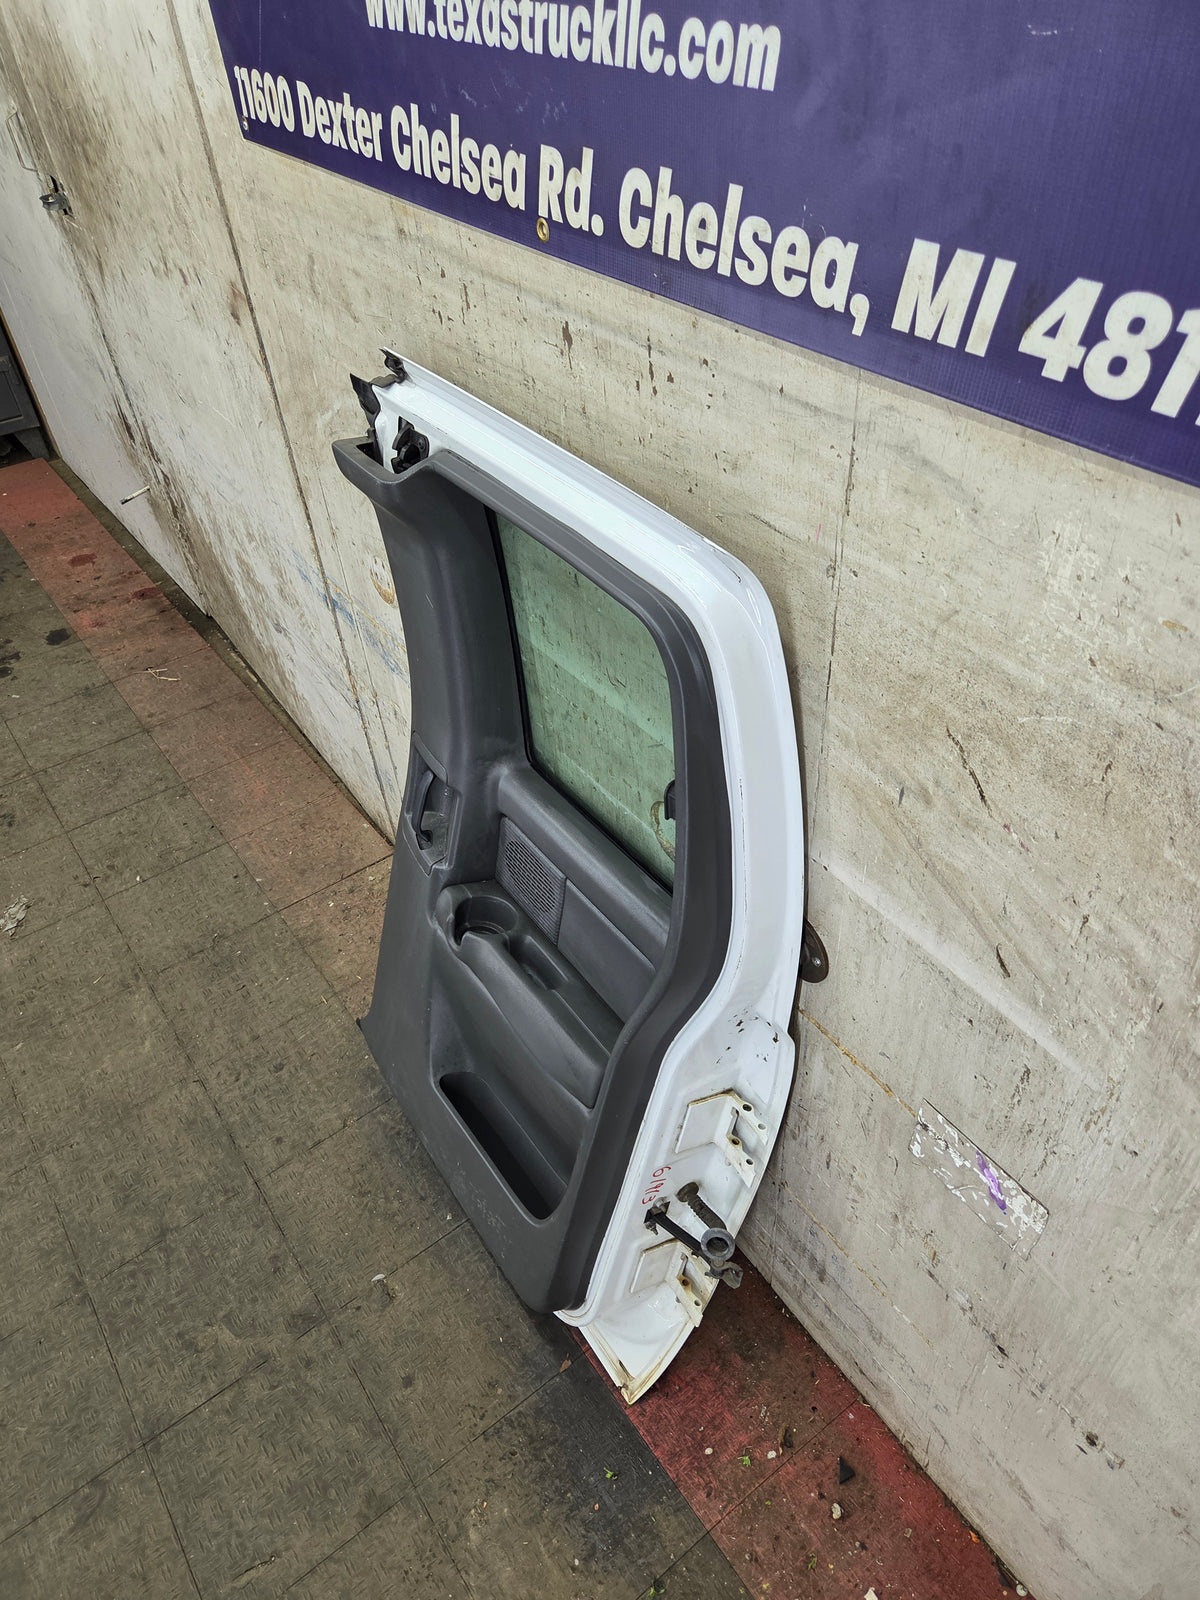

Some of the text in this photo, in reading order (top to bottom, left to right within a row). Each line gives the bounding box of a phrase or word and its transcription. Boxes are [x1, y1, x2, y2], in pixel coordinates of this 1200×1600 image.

[365, 0, 782, 92] www.texastruckllc.com
[233, 65, 1200, 426] 11600 Dexter Chelsea Rd. Chelsea, MI 481
